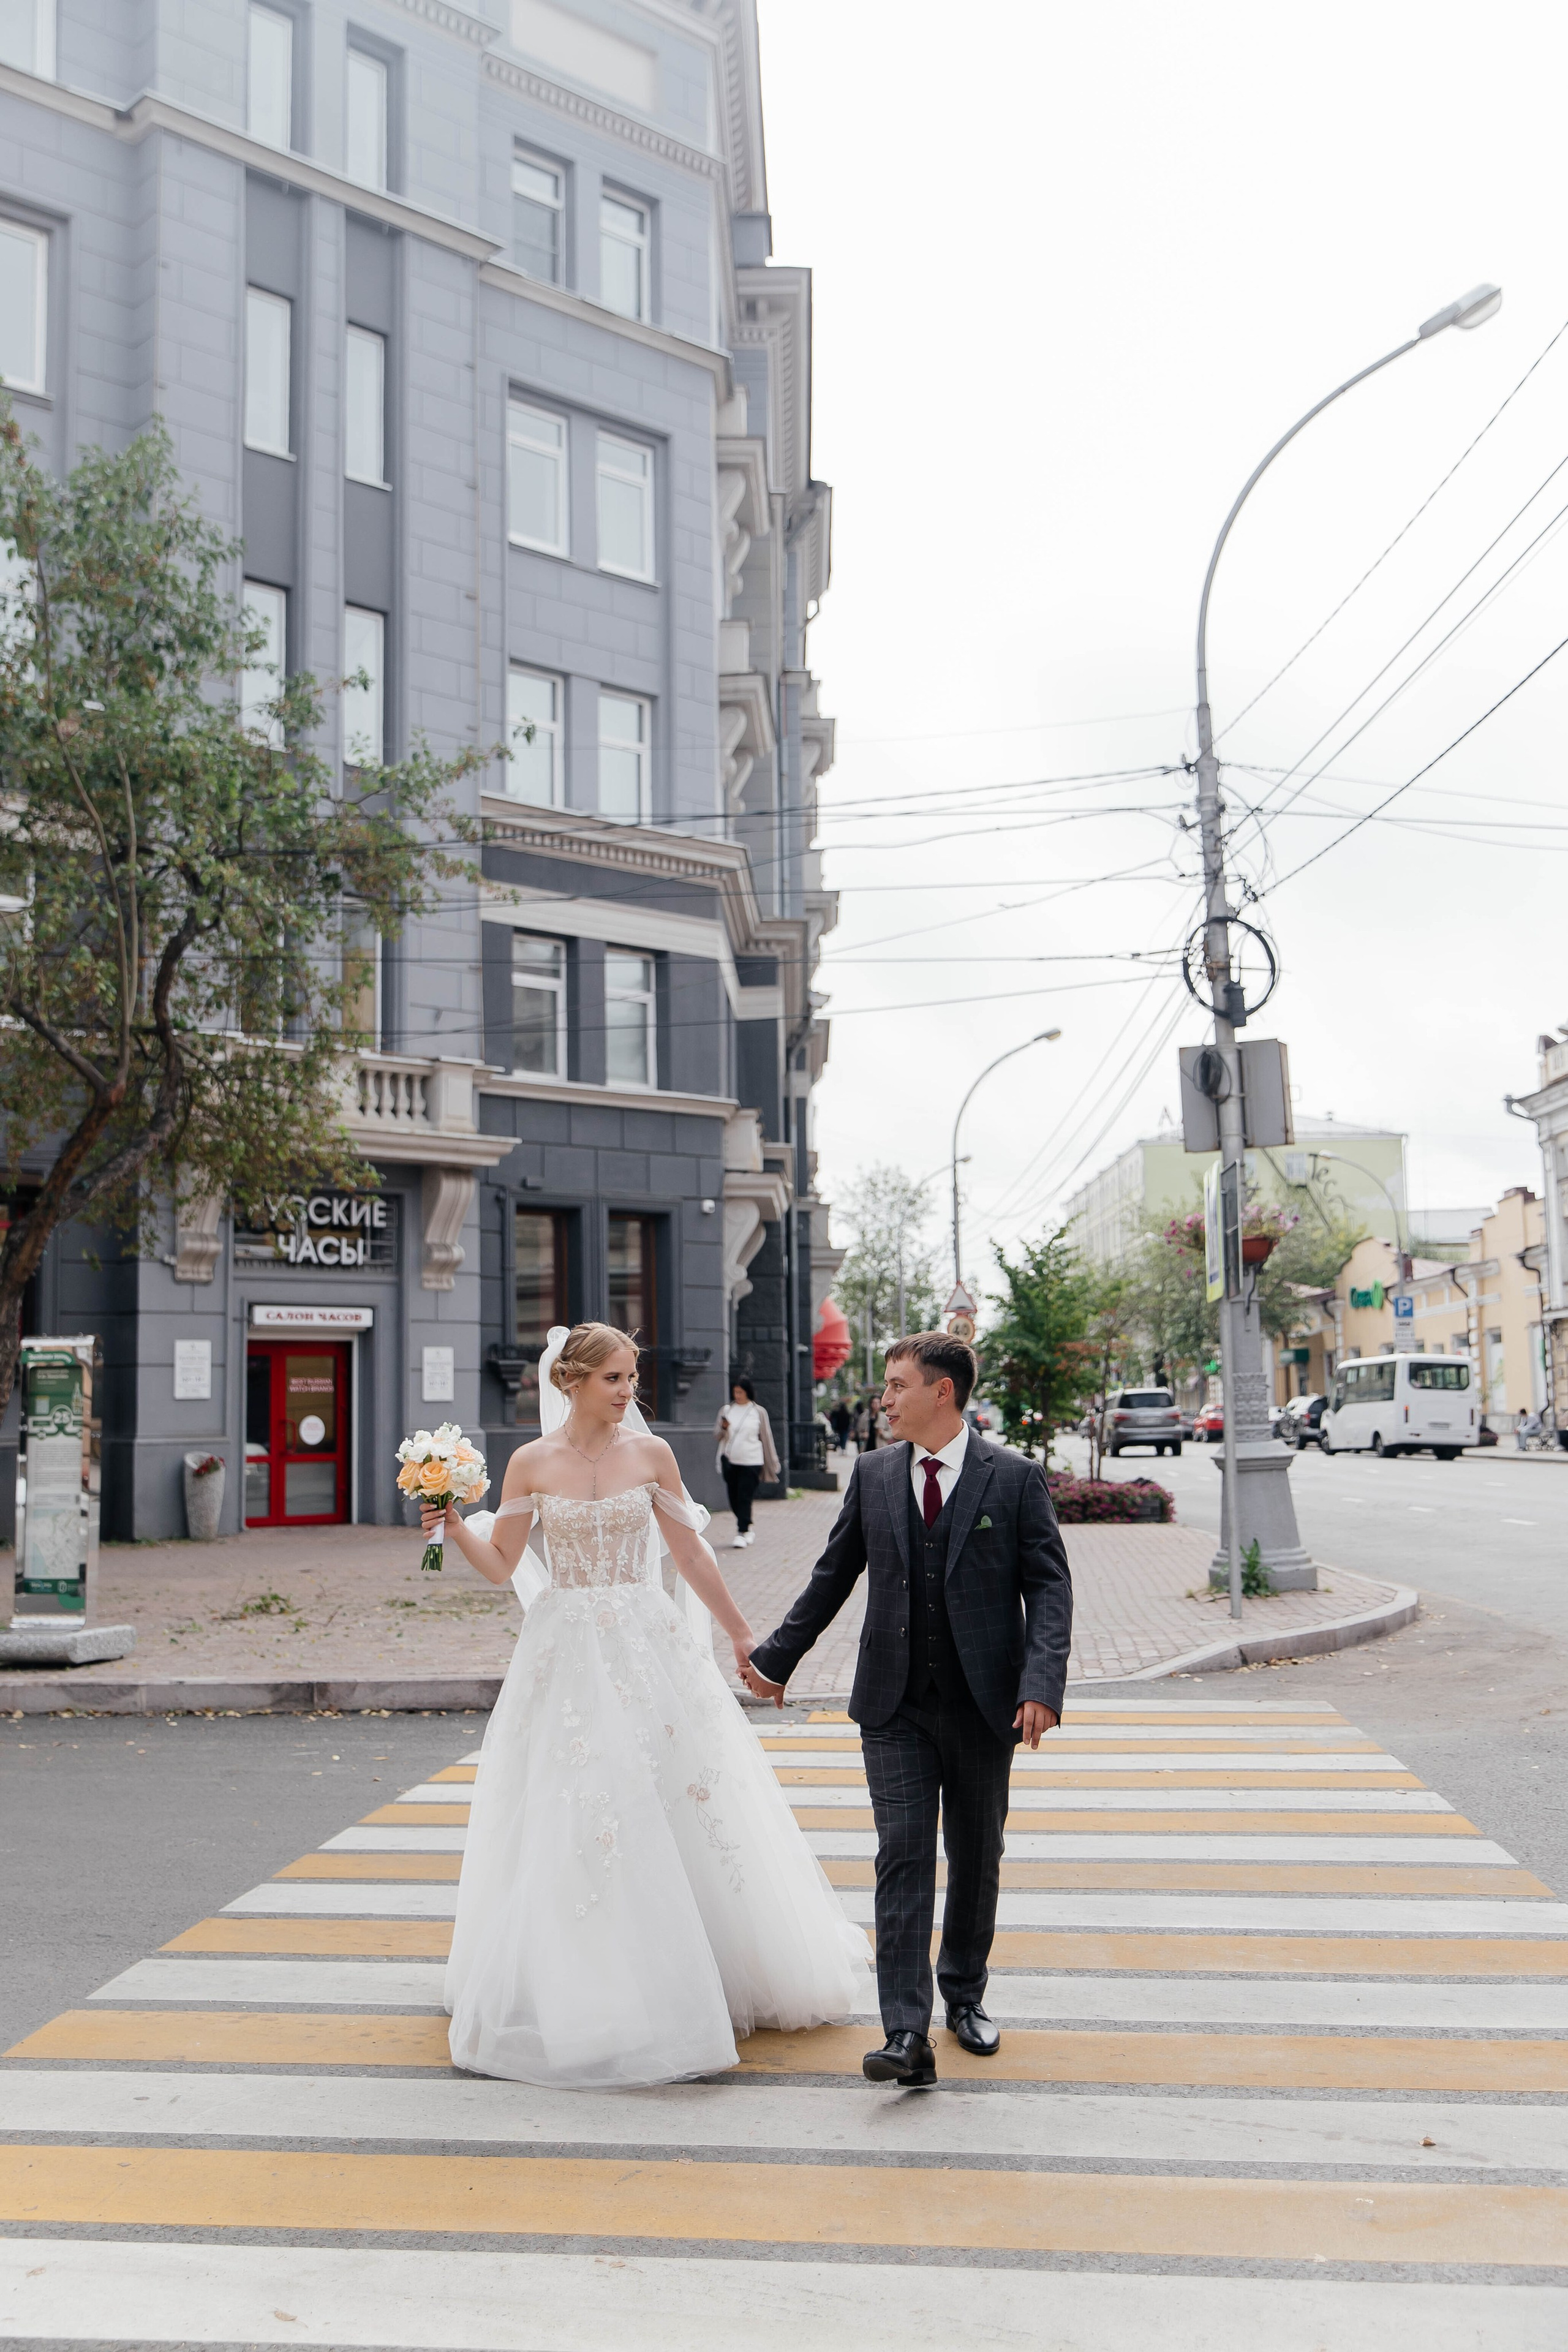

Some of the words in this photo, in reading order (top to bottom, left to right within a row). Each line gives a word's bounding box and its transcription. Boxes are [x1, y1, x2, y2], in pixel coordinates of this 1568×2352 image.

[248, 1194, 386, 1228] УССКИЕ
[277, 1234, 364, 1265] ЧАСЫ
[266, 1311, 314, 1321] САЛОН
[318, 1312, 363, 1322] ЧАСОВ
